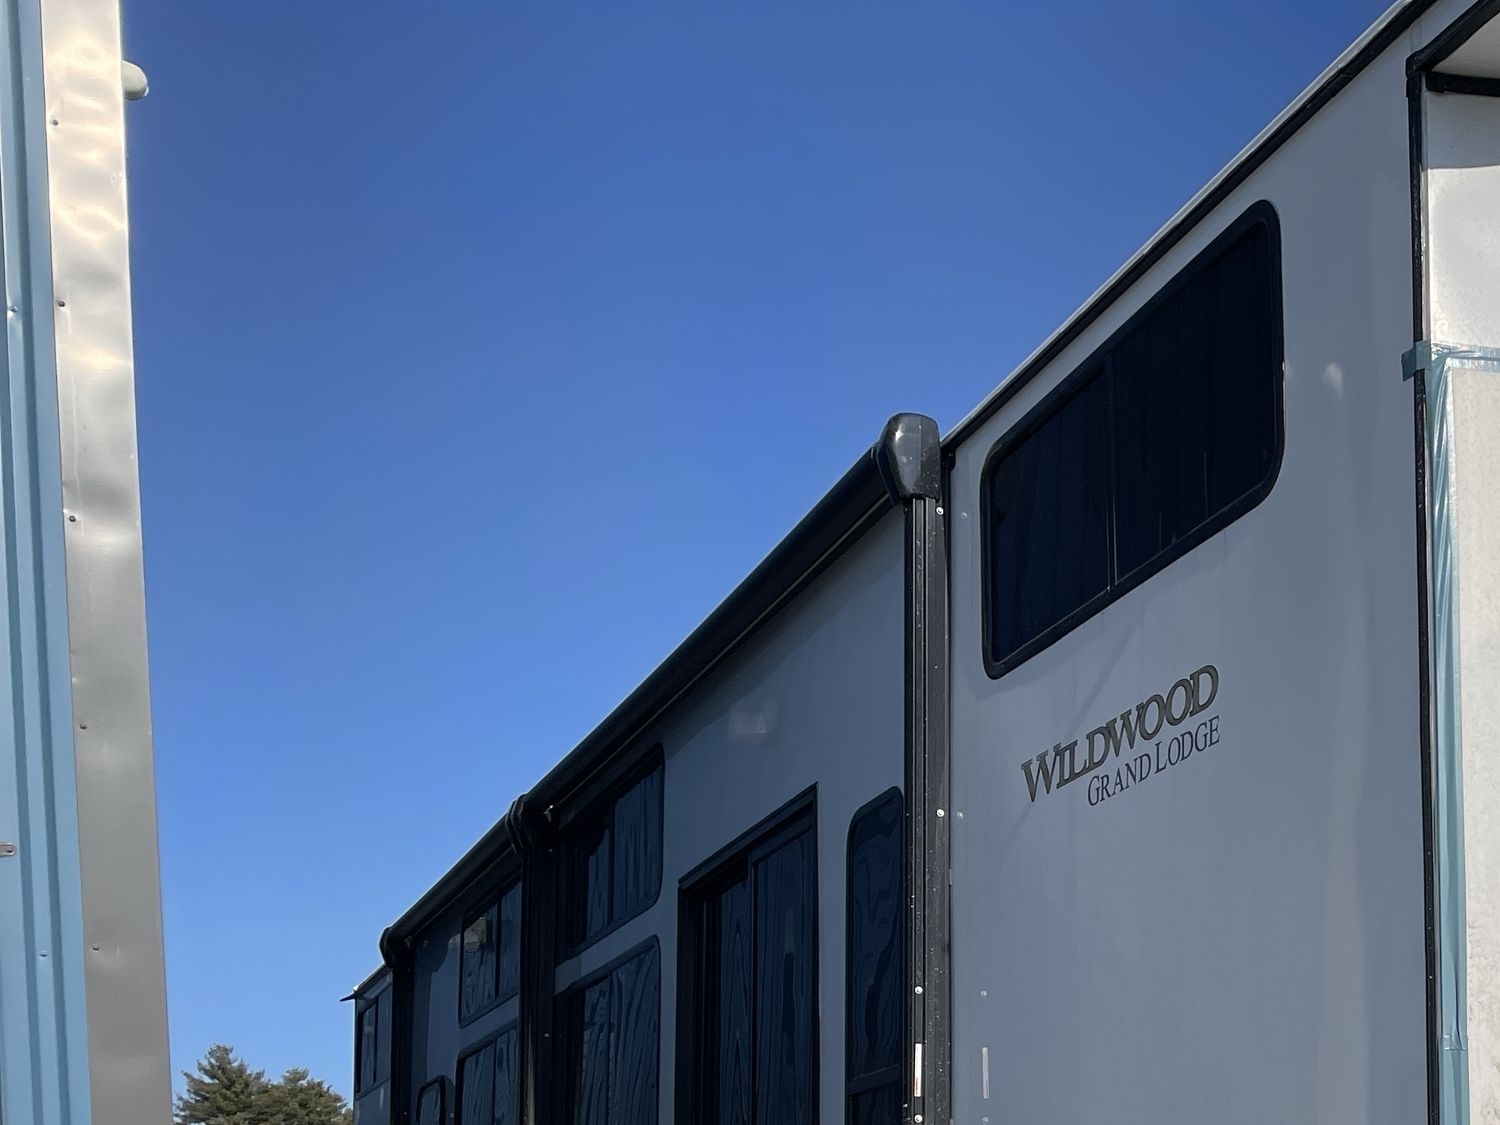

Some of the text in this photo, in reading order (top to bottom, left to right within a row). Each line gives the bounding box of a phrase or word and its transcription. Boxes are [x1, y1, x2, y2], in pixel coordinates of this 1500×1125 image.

[1021, 664, 1220, 803] WILDWOOD
[1087, 715, 1221, 807] GRAND LODGE
